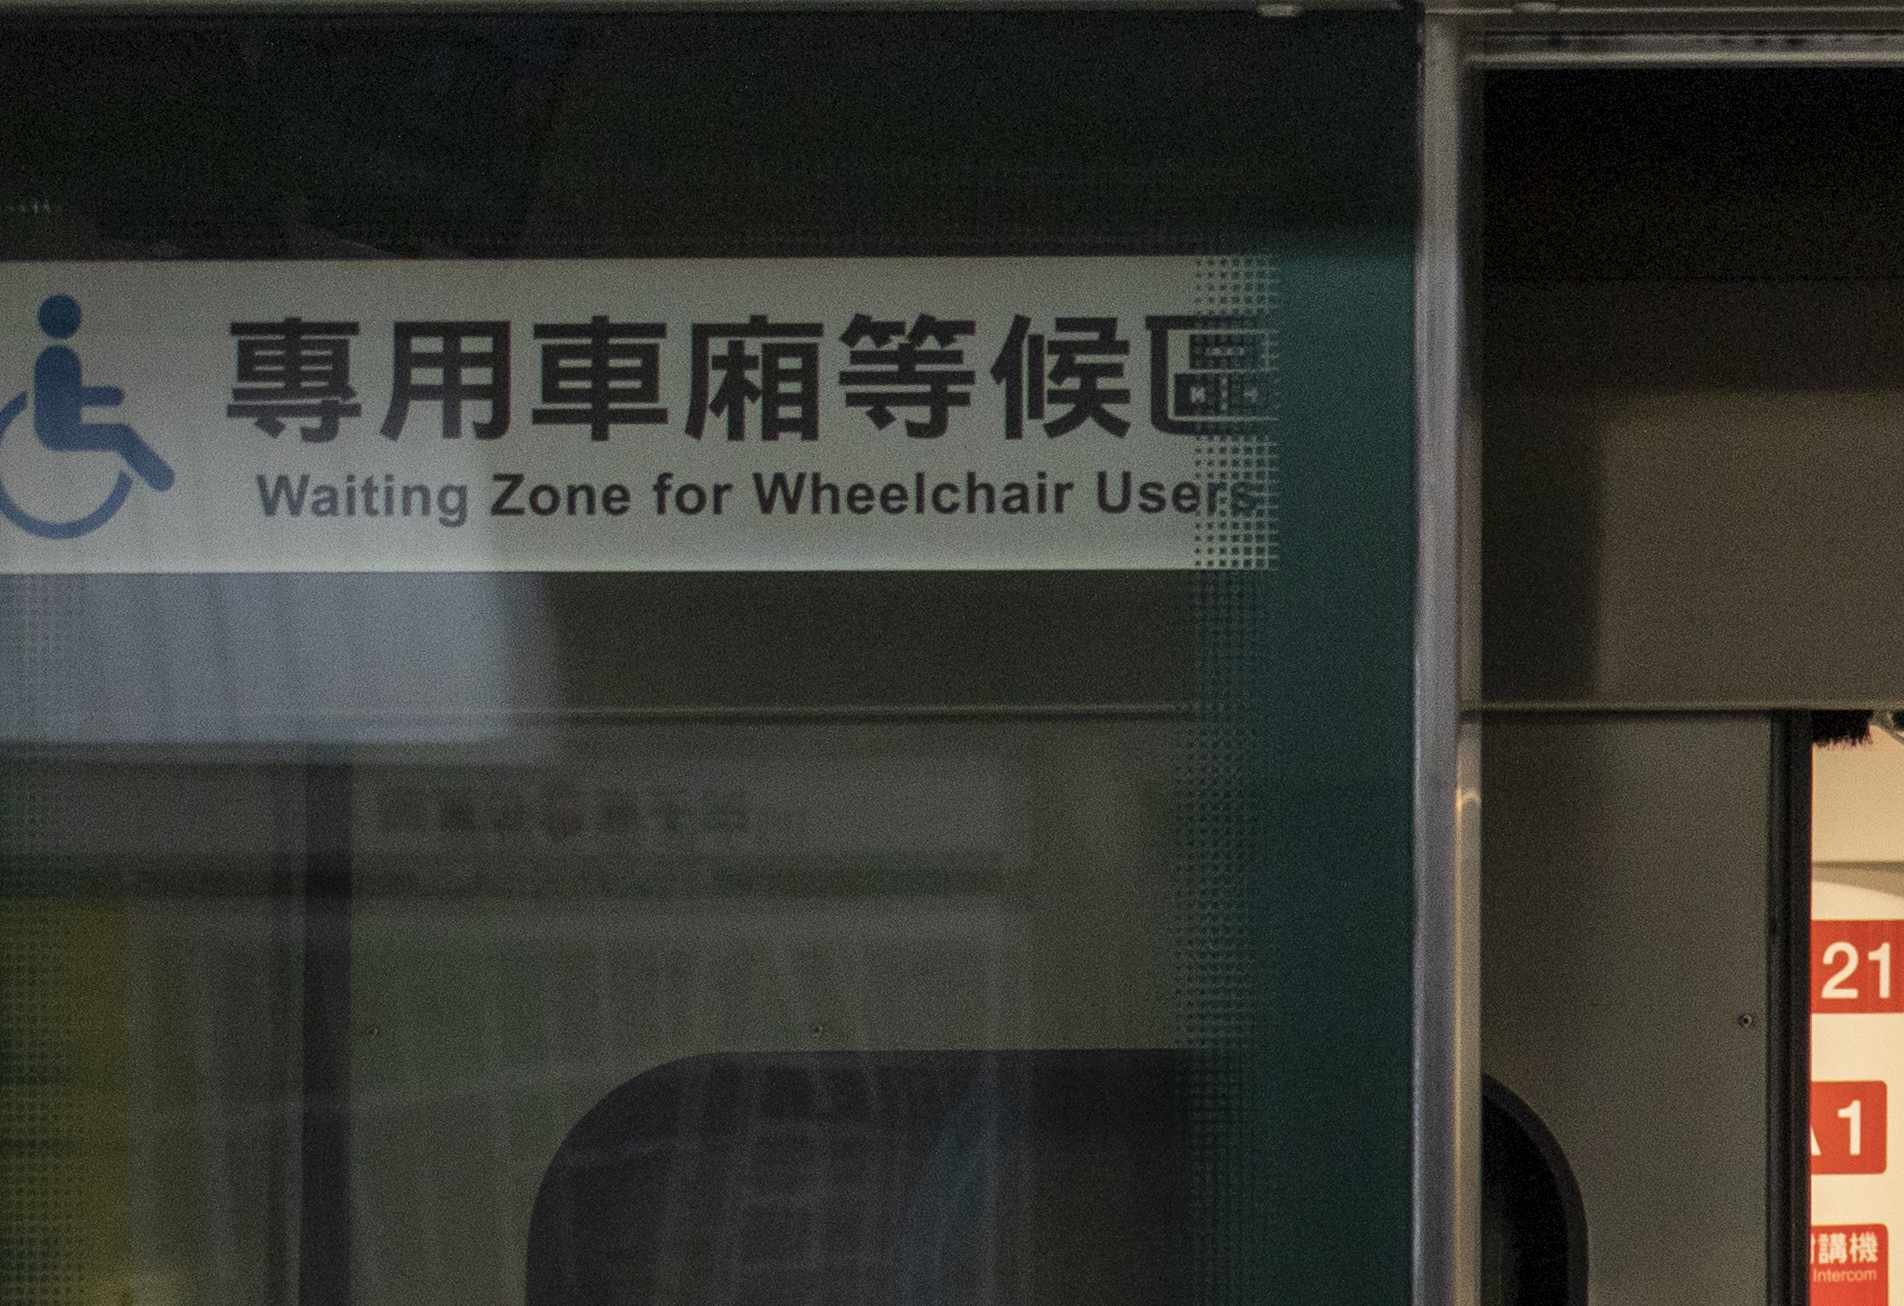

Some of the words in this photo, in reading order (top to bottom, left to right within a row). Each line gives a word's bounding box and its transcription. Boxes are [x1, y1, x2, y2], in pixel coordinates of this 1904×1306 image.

[226, 312, 1262, 444] 專用車廂等候區
[256, 472, 468, 528] Waiting
[490, 472, 632, 517] Zone
[653, 471, 734, 517] for
[753, 470, 1076, 516] Wheelchair
[1097, 470, 1258, 515] Users
[1810, 1232, 1878, 1264] 講機
[1813, 1269, 1877, 1282] Intercom
